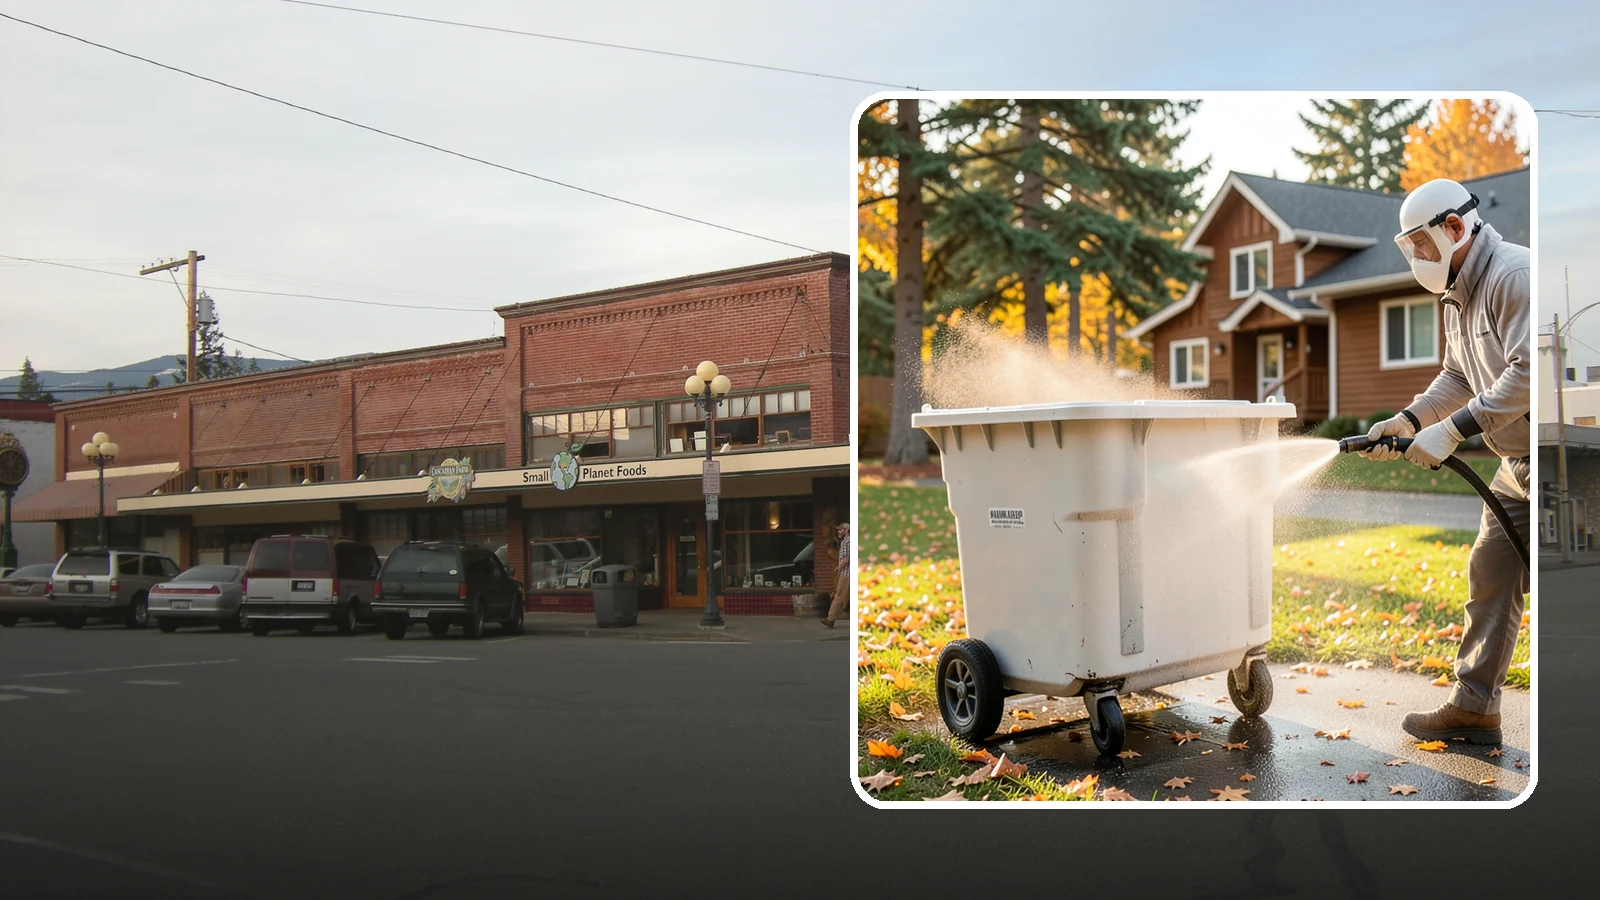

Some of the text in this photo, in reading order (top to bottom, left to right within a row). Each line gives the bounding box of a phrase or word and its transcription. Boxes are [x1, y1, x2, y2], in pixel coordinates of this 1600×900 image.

[523, 464, 647, 483] Small Planet Foods
